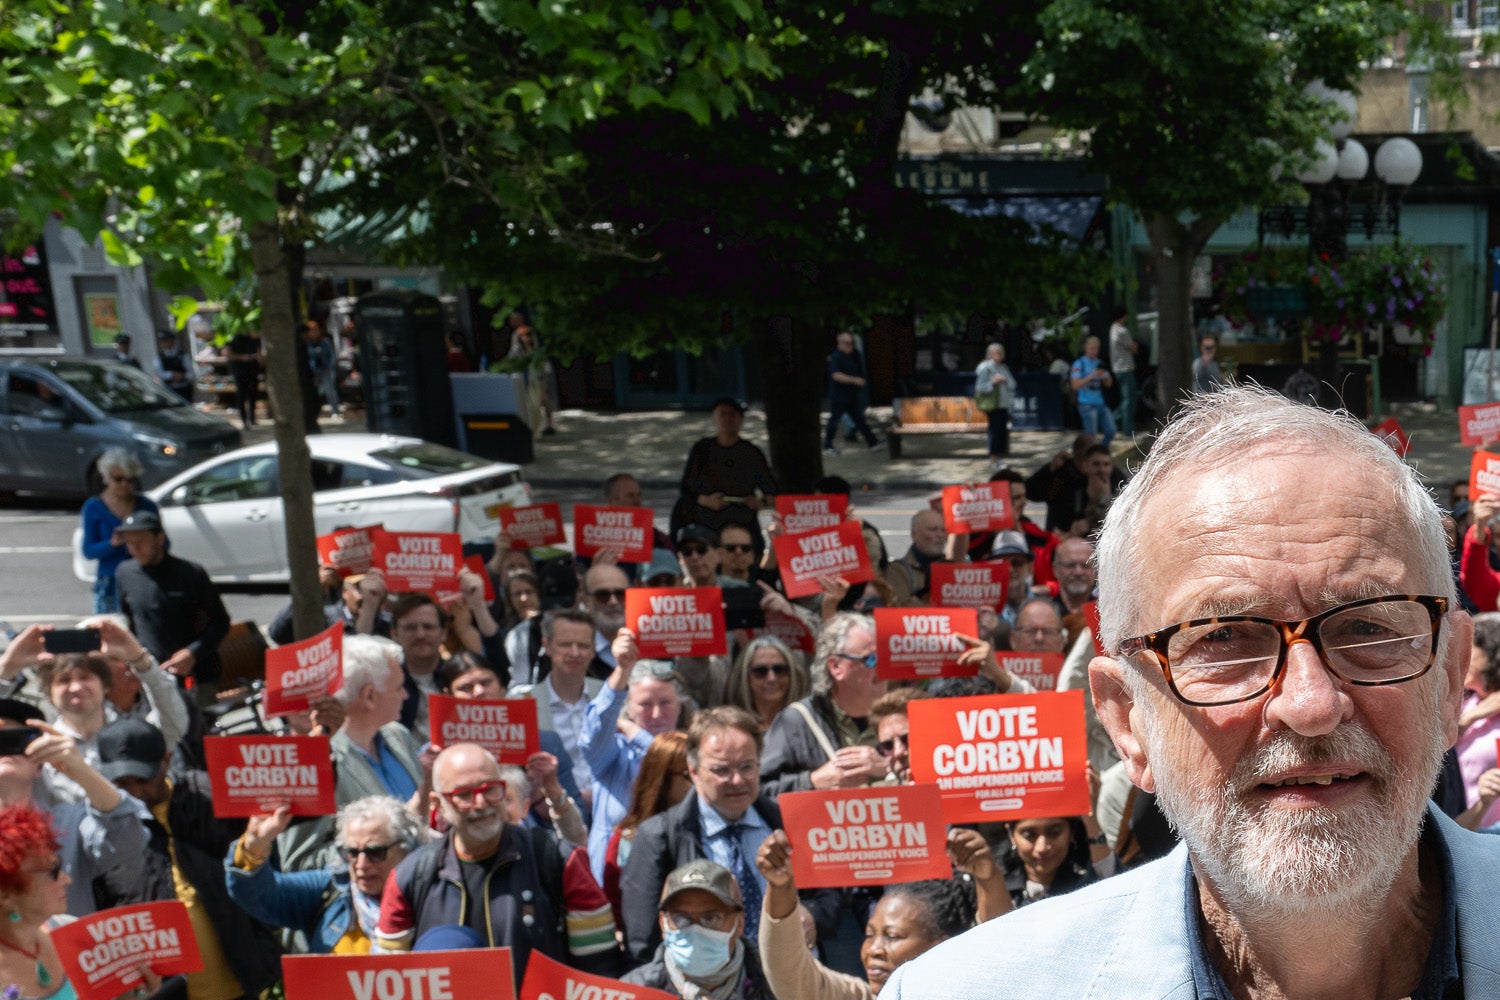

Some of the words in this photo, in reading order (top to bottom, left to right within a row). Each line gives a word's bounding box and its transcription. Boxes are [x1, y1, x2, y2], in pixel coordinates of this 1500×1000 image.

[514, 507, 545, 523] VOTE
[794, 499, 830, 516] VOTE
[952, 497, 1005, 516] CORBYN
[507, 519, 557, 537] CORBYN
[595, 511, 634, 527] VOTE
[785, 512, 841, 533] CORBYN
[584, 525, 645, 542] CORBYN
[799, 531, 842, 554] VOTE
[398, 536, 442, 553] VOTE
[385, 552, 454, 570] CORBYN
[790, 547, 859, 573] CORBYN
[954, 569, 992, 584] VOTE
[941, 582, 1001, 599] CORBYN
[650, 595, 697, 614] VOTE
[637, 614, 714, 633] CORBYN
[903, 615, 951, 634] VOTE
[295, 636, 334, 666] VOTE
[889, 633, 966, 654] CORBYN
[281, 653, 340, 690] CORBYN
[1002, 658, 1043, 675] VOTE
[457, 703, 510, 724] VOTE
[955, 705, 1039, 742] VOTE
[442, 722, 526, 742] CORBYN
[239, 744, 299, 766] VOTE
[932, 736, 1064, 776] CORBYN
[224, 765, 319, 788] CORBYN
[953, 773, 1029, 790] INDEPENDENT
[1030, 769, 1064, 784] VOICE
[825, 797, 902, 825] VOTE
[807, 822, 928, 852] CORBYN
[812, 852, 827, 863] AN
[828, 849, 897, 863] INDEPENDENT
[898, 847, 929, 859] VOICE
[86, 911, 156, 944] VOTE
[78, 928, 181, 974] CORBYN
